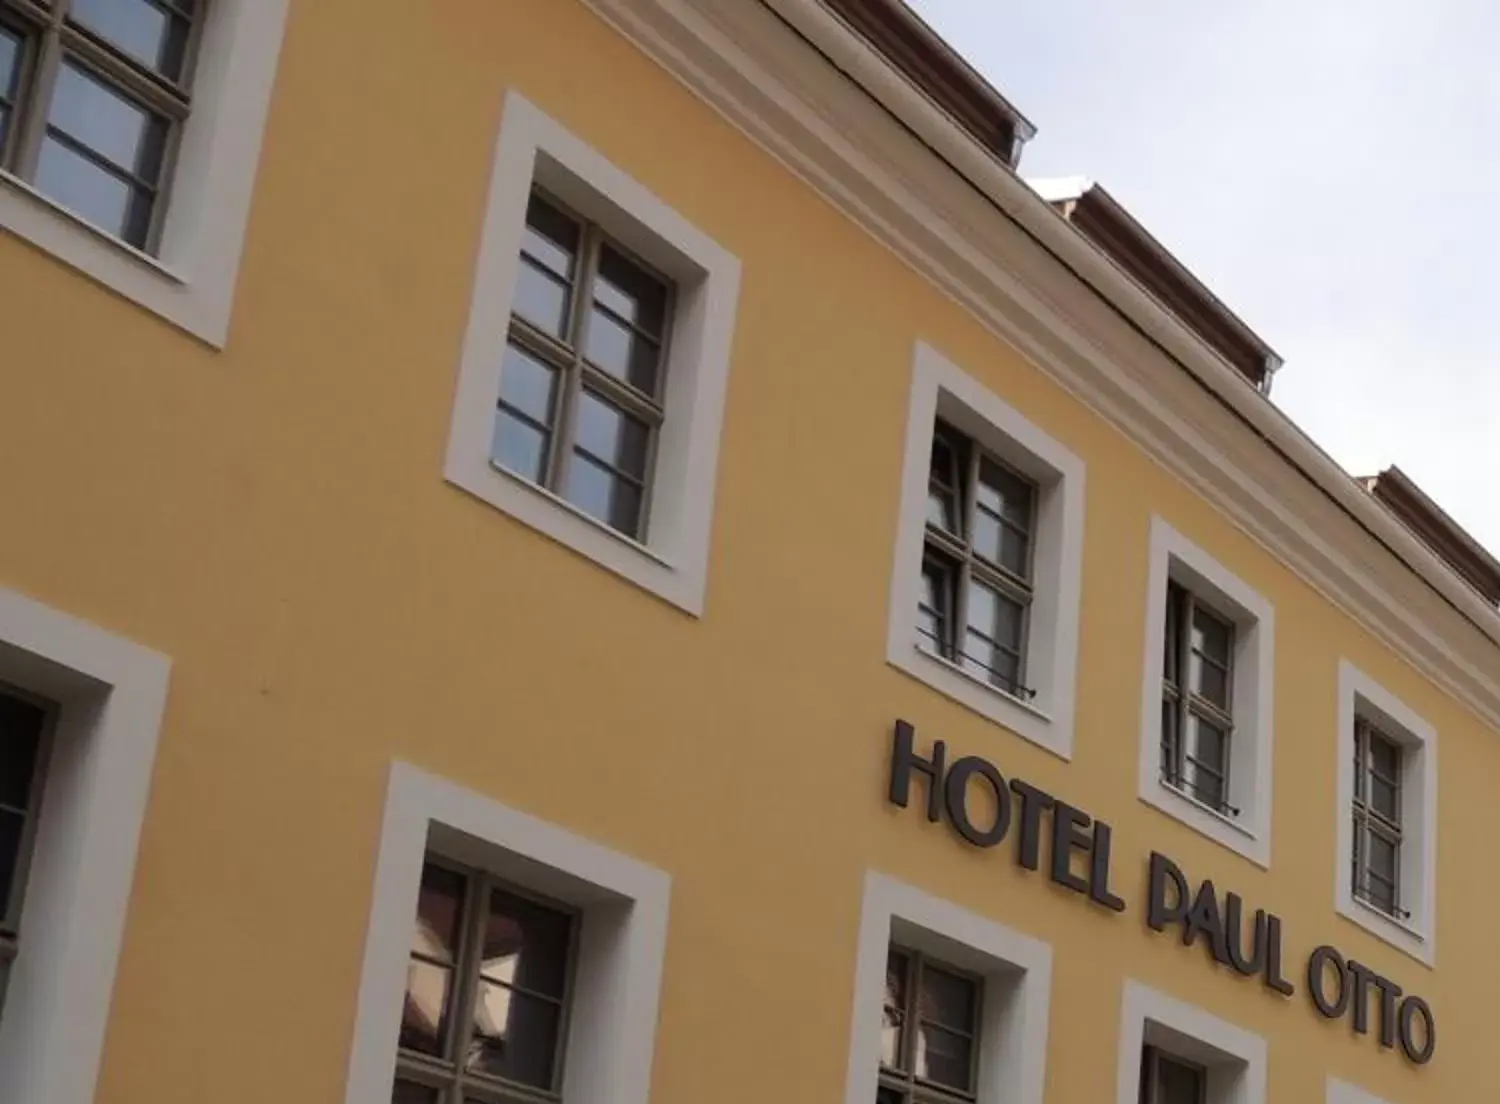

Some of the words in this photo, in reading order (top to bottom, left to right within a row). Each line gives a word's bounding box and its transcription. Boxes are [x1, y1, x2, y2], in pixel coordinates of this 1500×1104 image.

[889, 719, 1125, 912] HOTEL
[1147, 850, 1294, 996] PAUL
[1308, 945, 1435, 1065] OTTO
